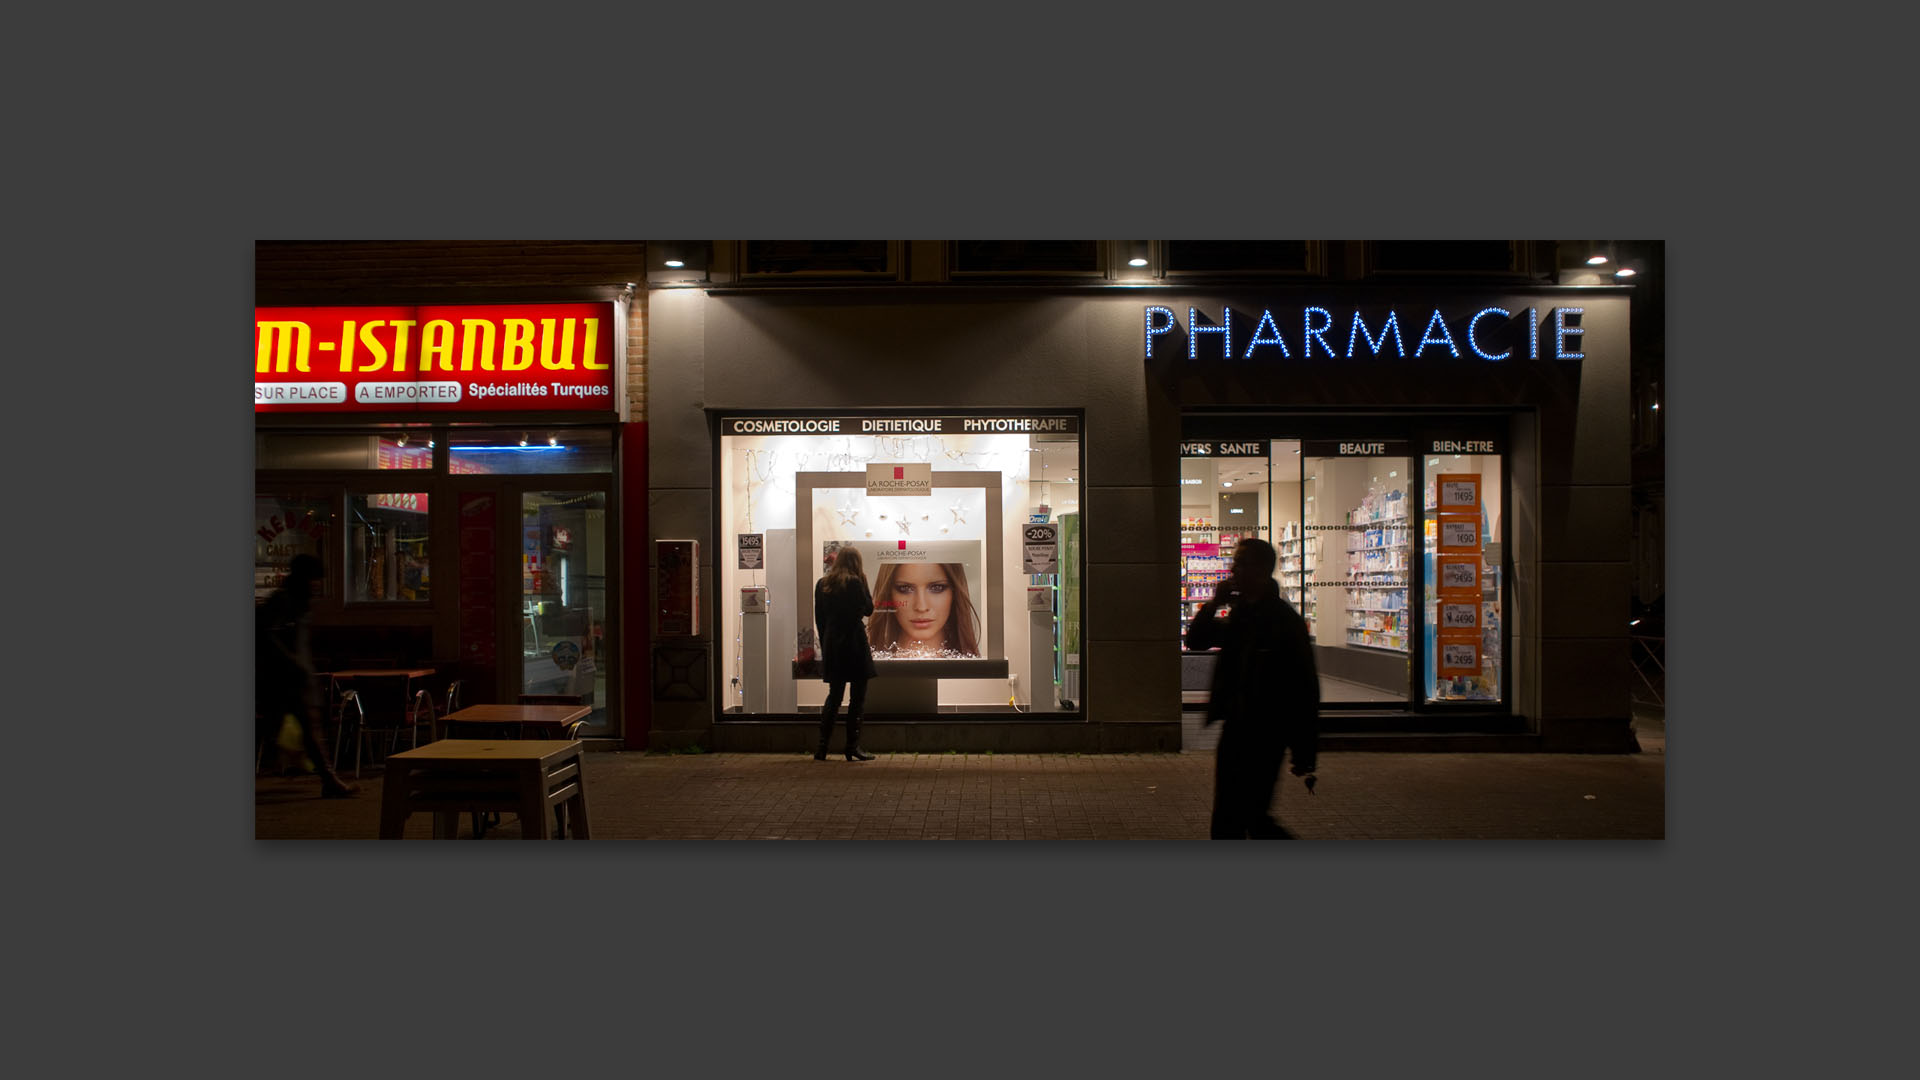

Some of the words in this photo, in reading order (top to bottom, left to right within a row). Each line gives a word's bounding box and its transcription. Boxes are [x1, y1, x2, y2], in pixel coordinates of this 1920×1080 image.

[1144, 305, 1586, 360] PHARMACIE
[256, 318, 609, 373] M-ISTANBUL
[255, 386, 285, 400] SUR
[289, 386, 339, 399] PLACE
[359, 386, 370, 399] A
[374, 385, 458, 398] EMPORTER
[468, 382, 548, 399] Spécialités
[550, 382, 609, 399] Turques
[733, 420, 840, 433] COSMETOLOGIE
[861, 419, 942, 432] DIETIETIQUE
[963, 419, 1067, 431] PHYTOTHERAPIE
[1220, 443, 1260, 455] SANTE
[1339, 443, 1385, 455] BEAUTE
[1432, 441, 1494, 452] BIEN-ETRE
[867, 480, 878, 488] LA
[878, 480, 930, 488] ROCHE-POSAY
[1027, 529, 1052, 539] -20%
